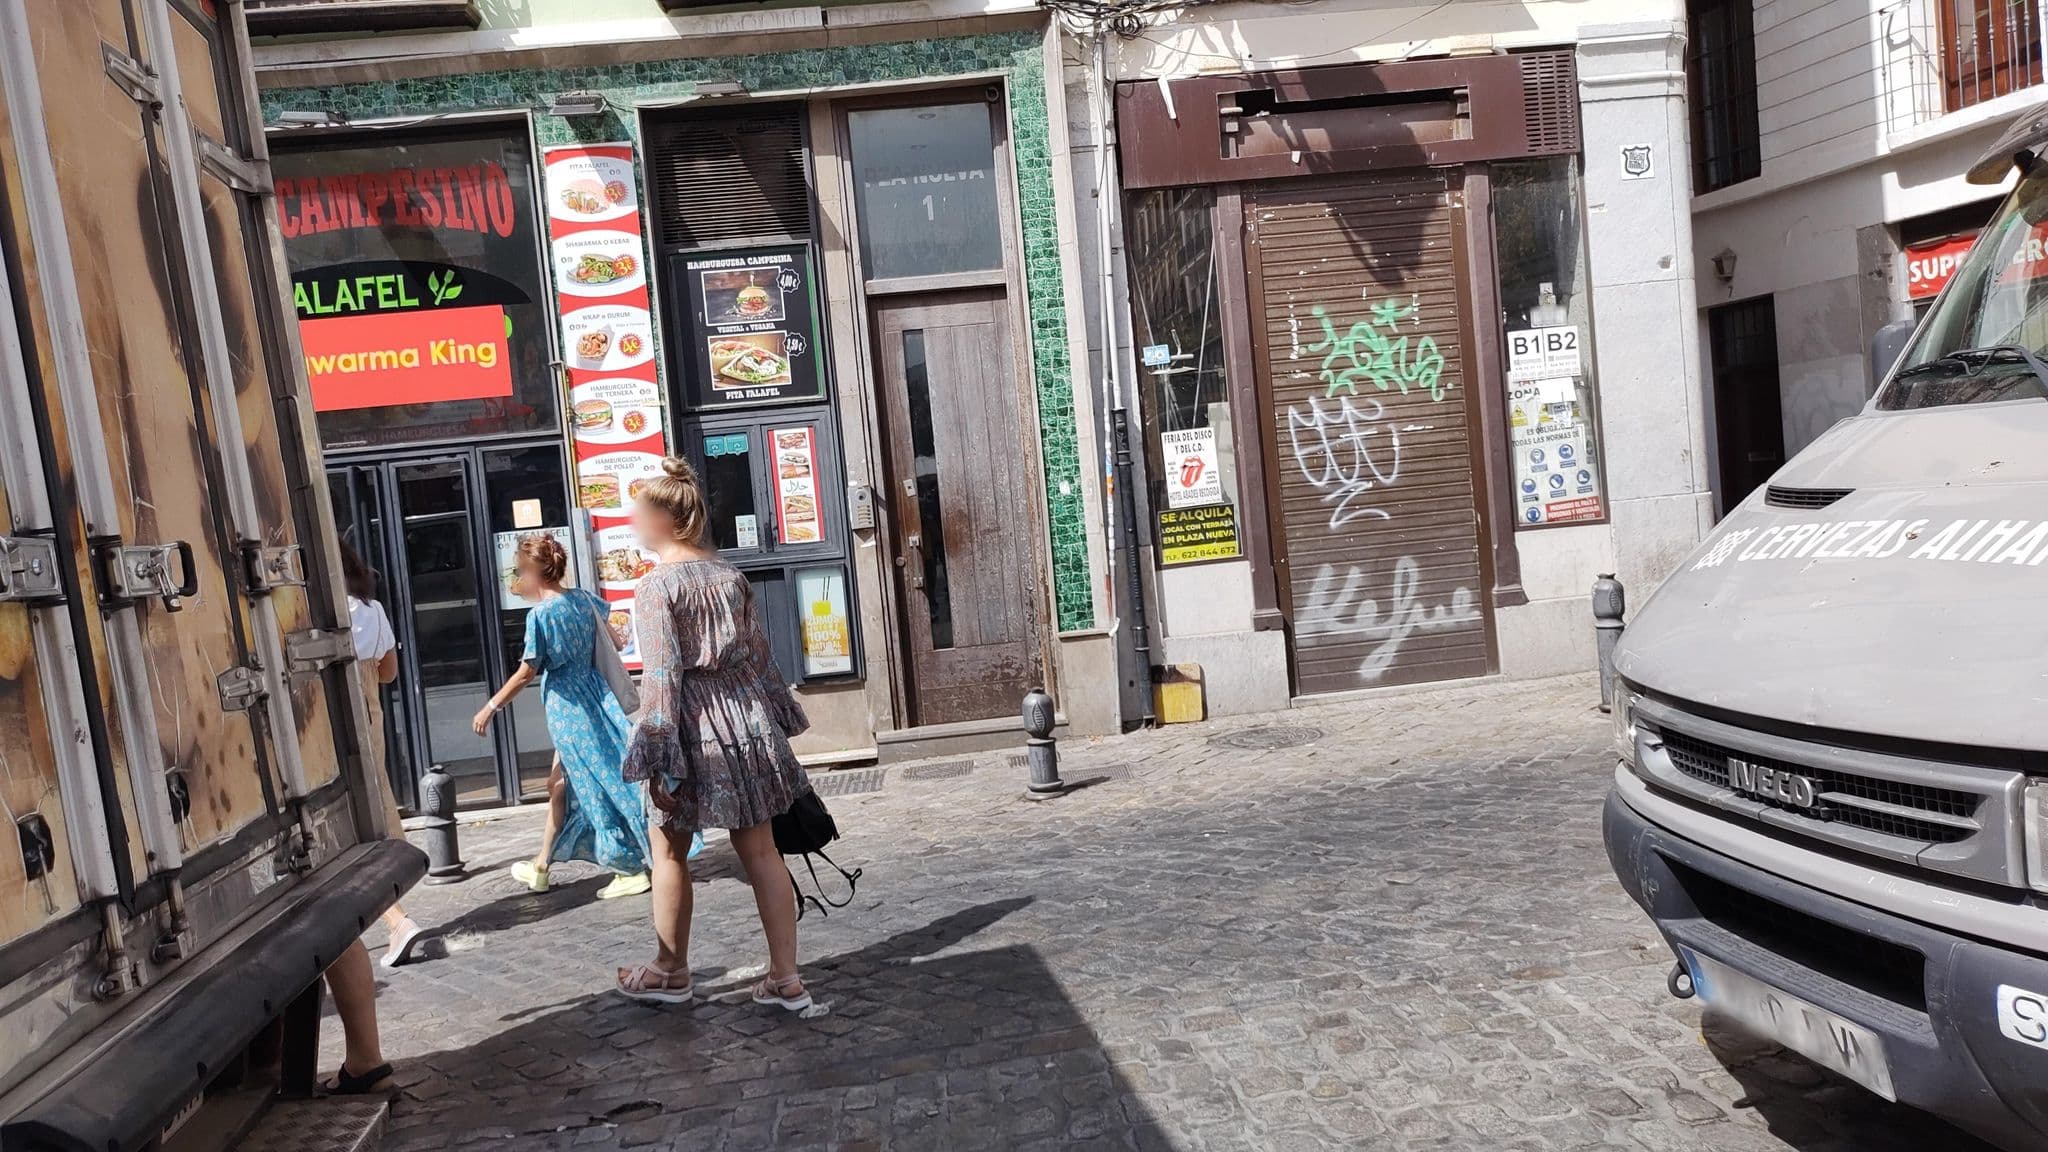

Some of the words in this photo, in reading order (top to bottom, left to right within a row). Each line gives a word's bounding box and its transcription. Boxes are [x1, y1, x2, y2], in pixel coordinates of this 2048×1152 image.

[274, 163, 515, 238] CAMPESINO
[921, 194, 935, 221] 1
[565, 240, 602, 248] SHAWARMA
[687, 258, 746, 270] HAMBURGUESA
[747, 254, 793, 266] CAMPESINA
[1513, 335, 1540, 356] B1
[1547, 332, 1577, 352] B2
[305, 347, 420, 377] warma
[429, 338, 498, 369] King
[590, 383, 637, 391] HAMBURGUESA
[725, 389, 744, 400] PITA
[745, 387, 780, 398] FALAFEL
[1163, 433, 1181, 444] FERIA
[1182, 431, 1194, 442] DEL
[1194, 429, 1213, 441] DISCO
[1174, 445, 1179, 454] Y
[1180, 444, 1191, 454] DEL
[595, 456, 642, 465] HAMBURGUESA
[1160, 512, 1177, 524] SE
[1179, 506, 1233, 521] ALQUILA
[1162, 526, 1185, 534] LOCAL
[1185, 523, 1201, 531] CON
[1201, 519, 1234, 529] TERRAZA
[1162, 536, 1175, 545] EN
[1176, 532, 1205, 543] PLAZA
[1205, 529, 1235, 540] NUEVA
[1737, 519, 1931, 562] CERVEZAS
[1908, 519, 2048, 566] ALHA
[1181, 550, 1197, 560] 622
[1220, 546, 1236, 555] 672
[808, 630, 841, 642] 100%
[1726, 756, 1814, 808] IVECO
